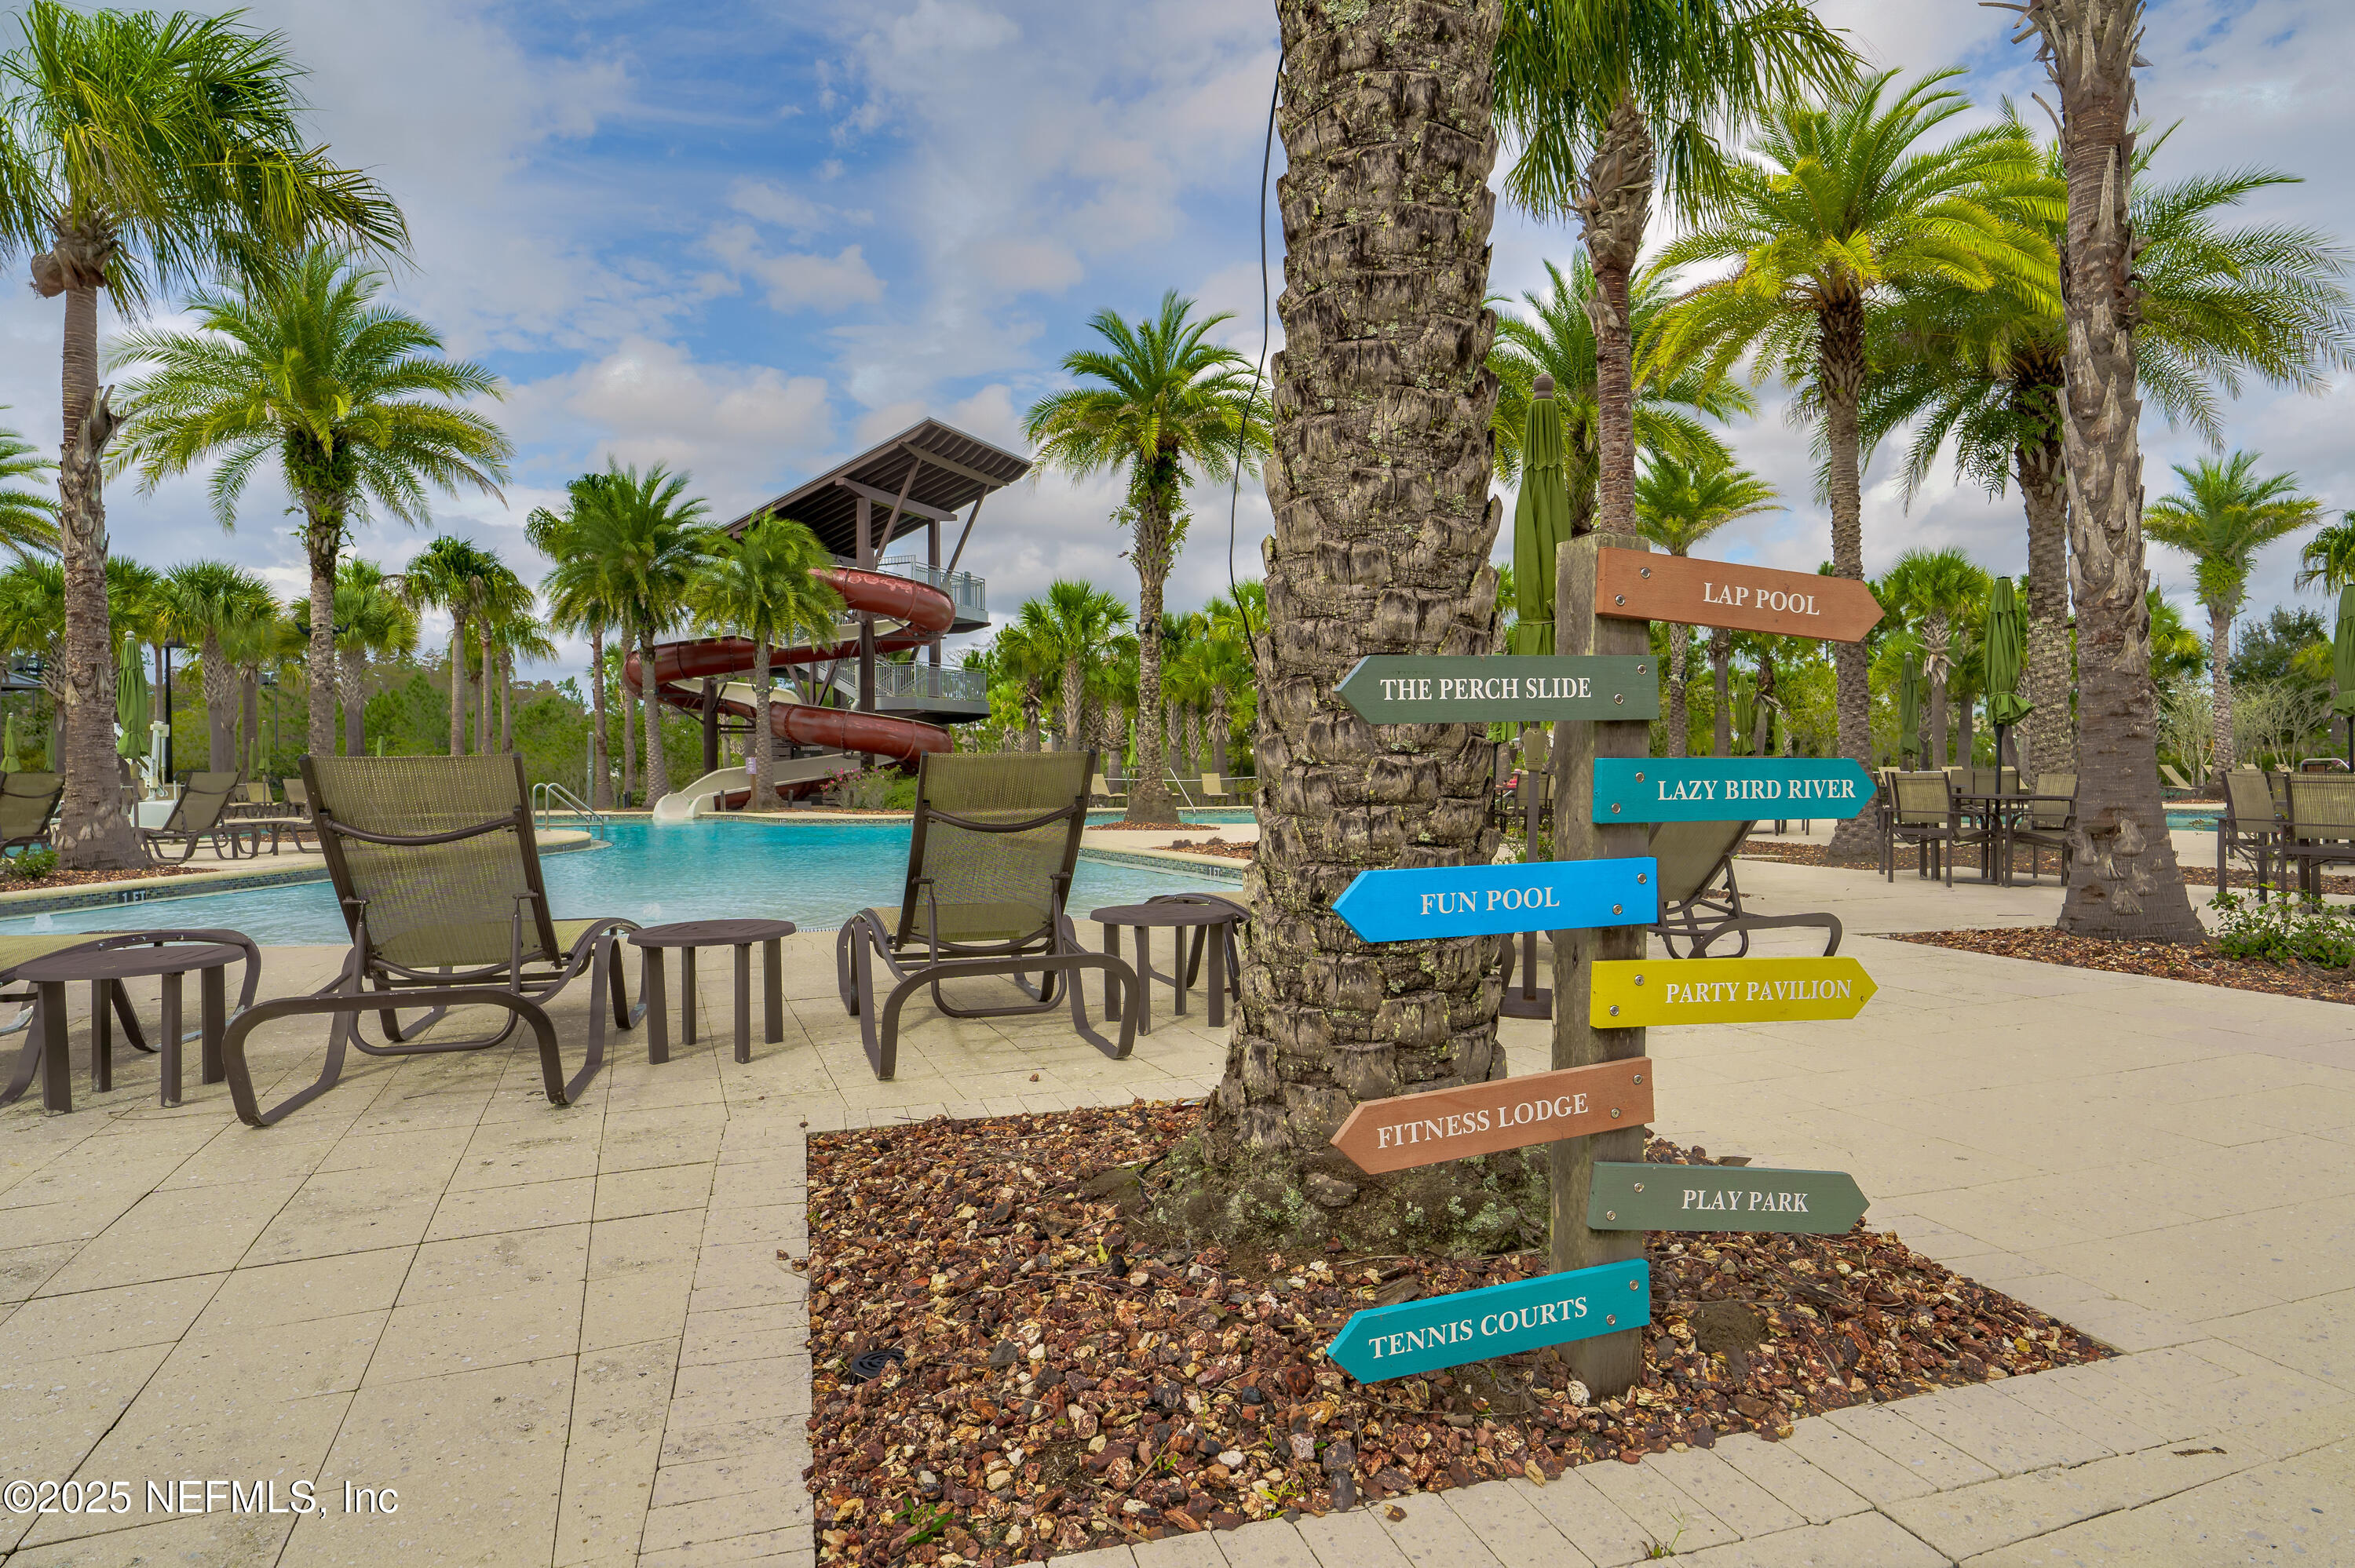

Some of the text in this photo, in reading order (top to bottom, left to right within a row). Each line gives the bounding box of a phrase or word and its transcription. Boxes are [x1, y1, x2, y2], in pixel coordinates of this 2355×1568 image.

[1703, 582, 1821, 616] LAP POOL
[1379, 677, 1592, 701] THE PERCH SLIDE
[1657, 779, 1857, 800] LAZY BIRD RIVER
[122, 890, 146, 903] 1 FT
[1420, 886, 1561, 916] FUN POOL
[1665, 979, 1853, 1004] PARTY PAVILION
[1377, 1092, 1590, 1149] FITNESS LODGE
[1681, 1189, 1809, 1212] PLAY PARK
[1368, 1296, 1588, 1359] TENNIS COURTS
